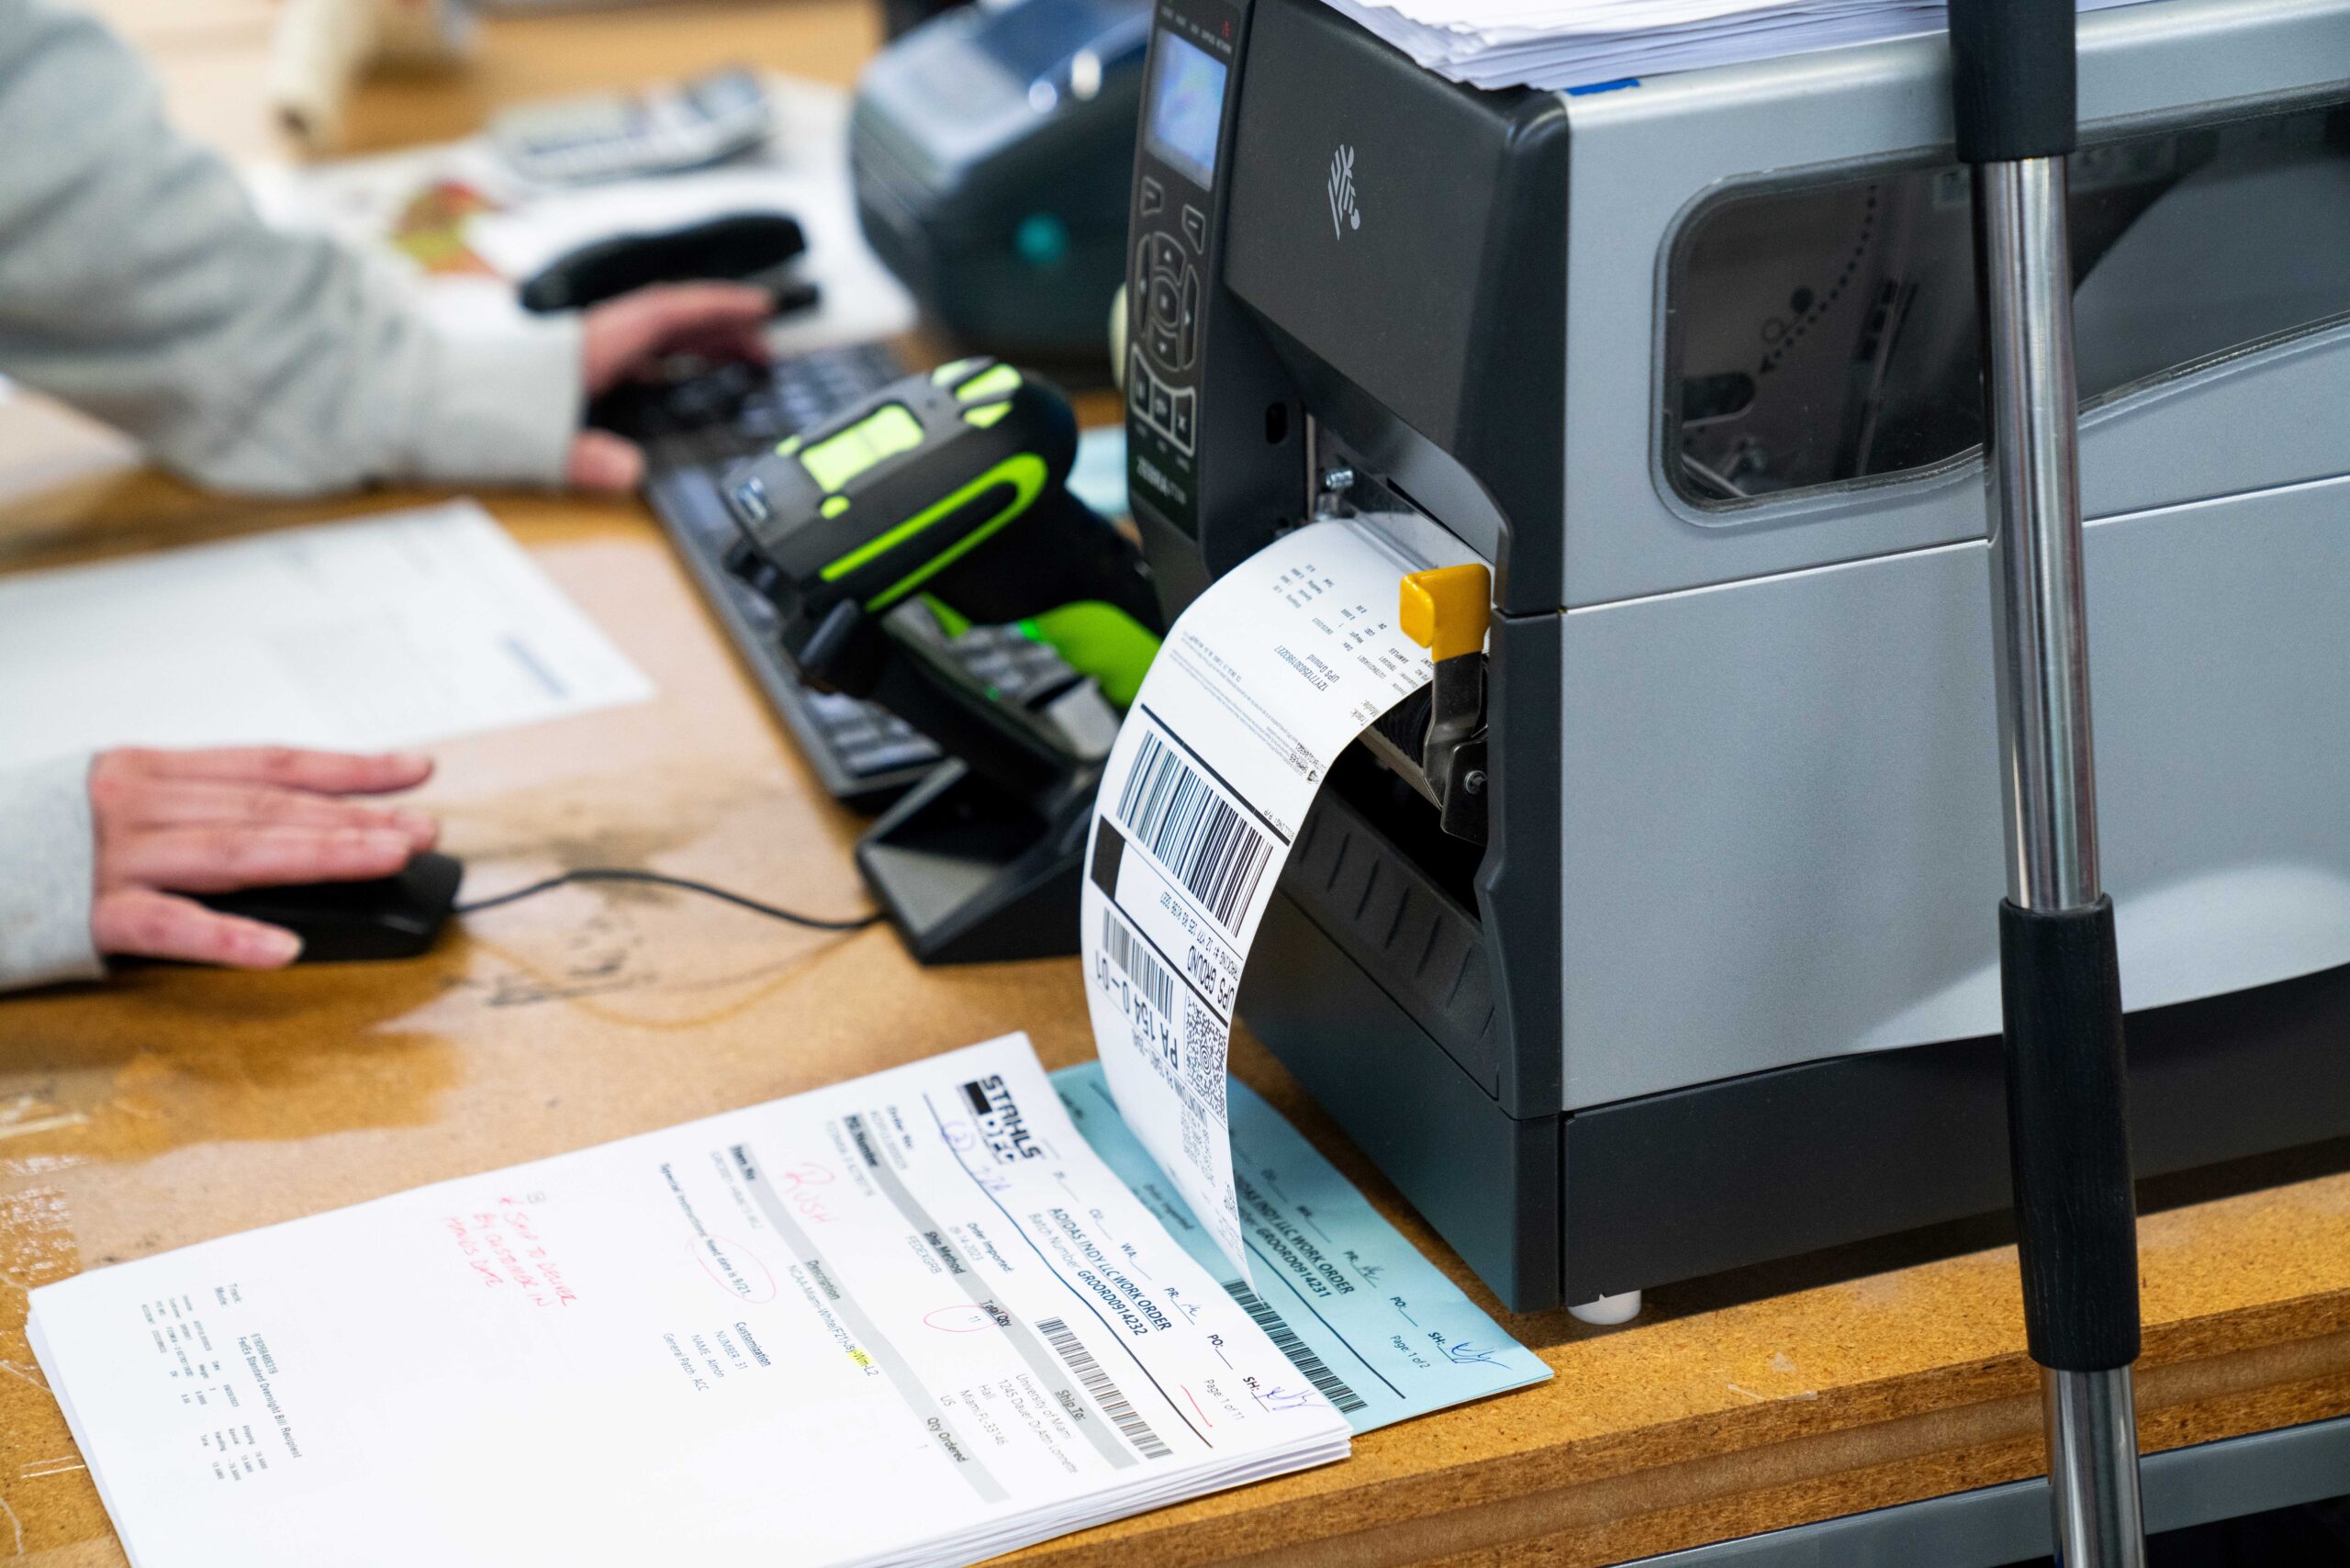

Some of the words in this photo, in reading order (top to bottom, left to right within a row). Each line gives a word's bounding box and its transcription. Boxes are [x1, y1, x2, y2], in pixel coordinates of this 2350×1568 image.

[1305, 654, 1328, 674] Ground
[1324, 669, 1340, 684] UPS
[1187, 945, 1217, 995] GROUND
[1134, 993, 1157, 1042] 154
[1159, 1022, 1179, 1071] PA
[967, 1222, 986, 1240] Order
[938, 1246, 967, 1275] Method
[1048, 1208, 1087, 1240] ADIDAS
[1080, 1238, 1106, 1263] INDY
[1099, 1262, 1120, 1278] LLC
[1113, 1275, 1144, 1301] WORK
[1137, 1295, 1172, 1331] ORDER
[1292, 1234, 1326, 1263] WORK
[1319, 1262, 1355, 1295] ORDER
[806, 1260, 841, 1301] Description
[979, 1299, 1001, 1318] Total
[1389, 1296, 1406, 1309] PO:
[733, 1321, 771, 1367] Customization
[1207, 1334, 1224, 1349] PO:
[1391, 1335, 1411, 1353] Page:
[1427, 1331, 1447, 1347] SH:
[237, 1336, 252, 1355] FedEx
[246, 1356, 267, 1383] Standard
[260, 1383, 281, 1415] Overnight
[274, 1414, 288, 1426] Bill
[281, 1427, 302, 1459] Recipient
[978, 1383, 998, 1401] Hall
[1015, 1372, 1049, 1412] University
[1243, 1376, 1259, 1392] SH:
[940, 1394, 957, 1408] US
[999, 1378, 1019, 1400] 1245
[1012, 1397, 1034, 1423] Dauer
[1056, 1388, 1076, 1411] Ship
[1069, 1405, 1087, 1422] To:
[938, 1431, 969, 1463] Ordered
